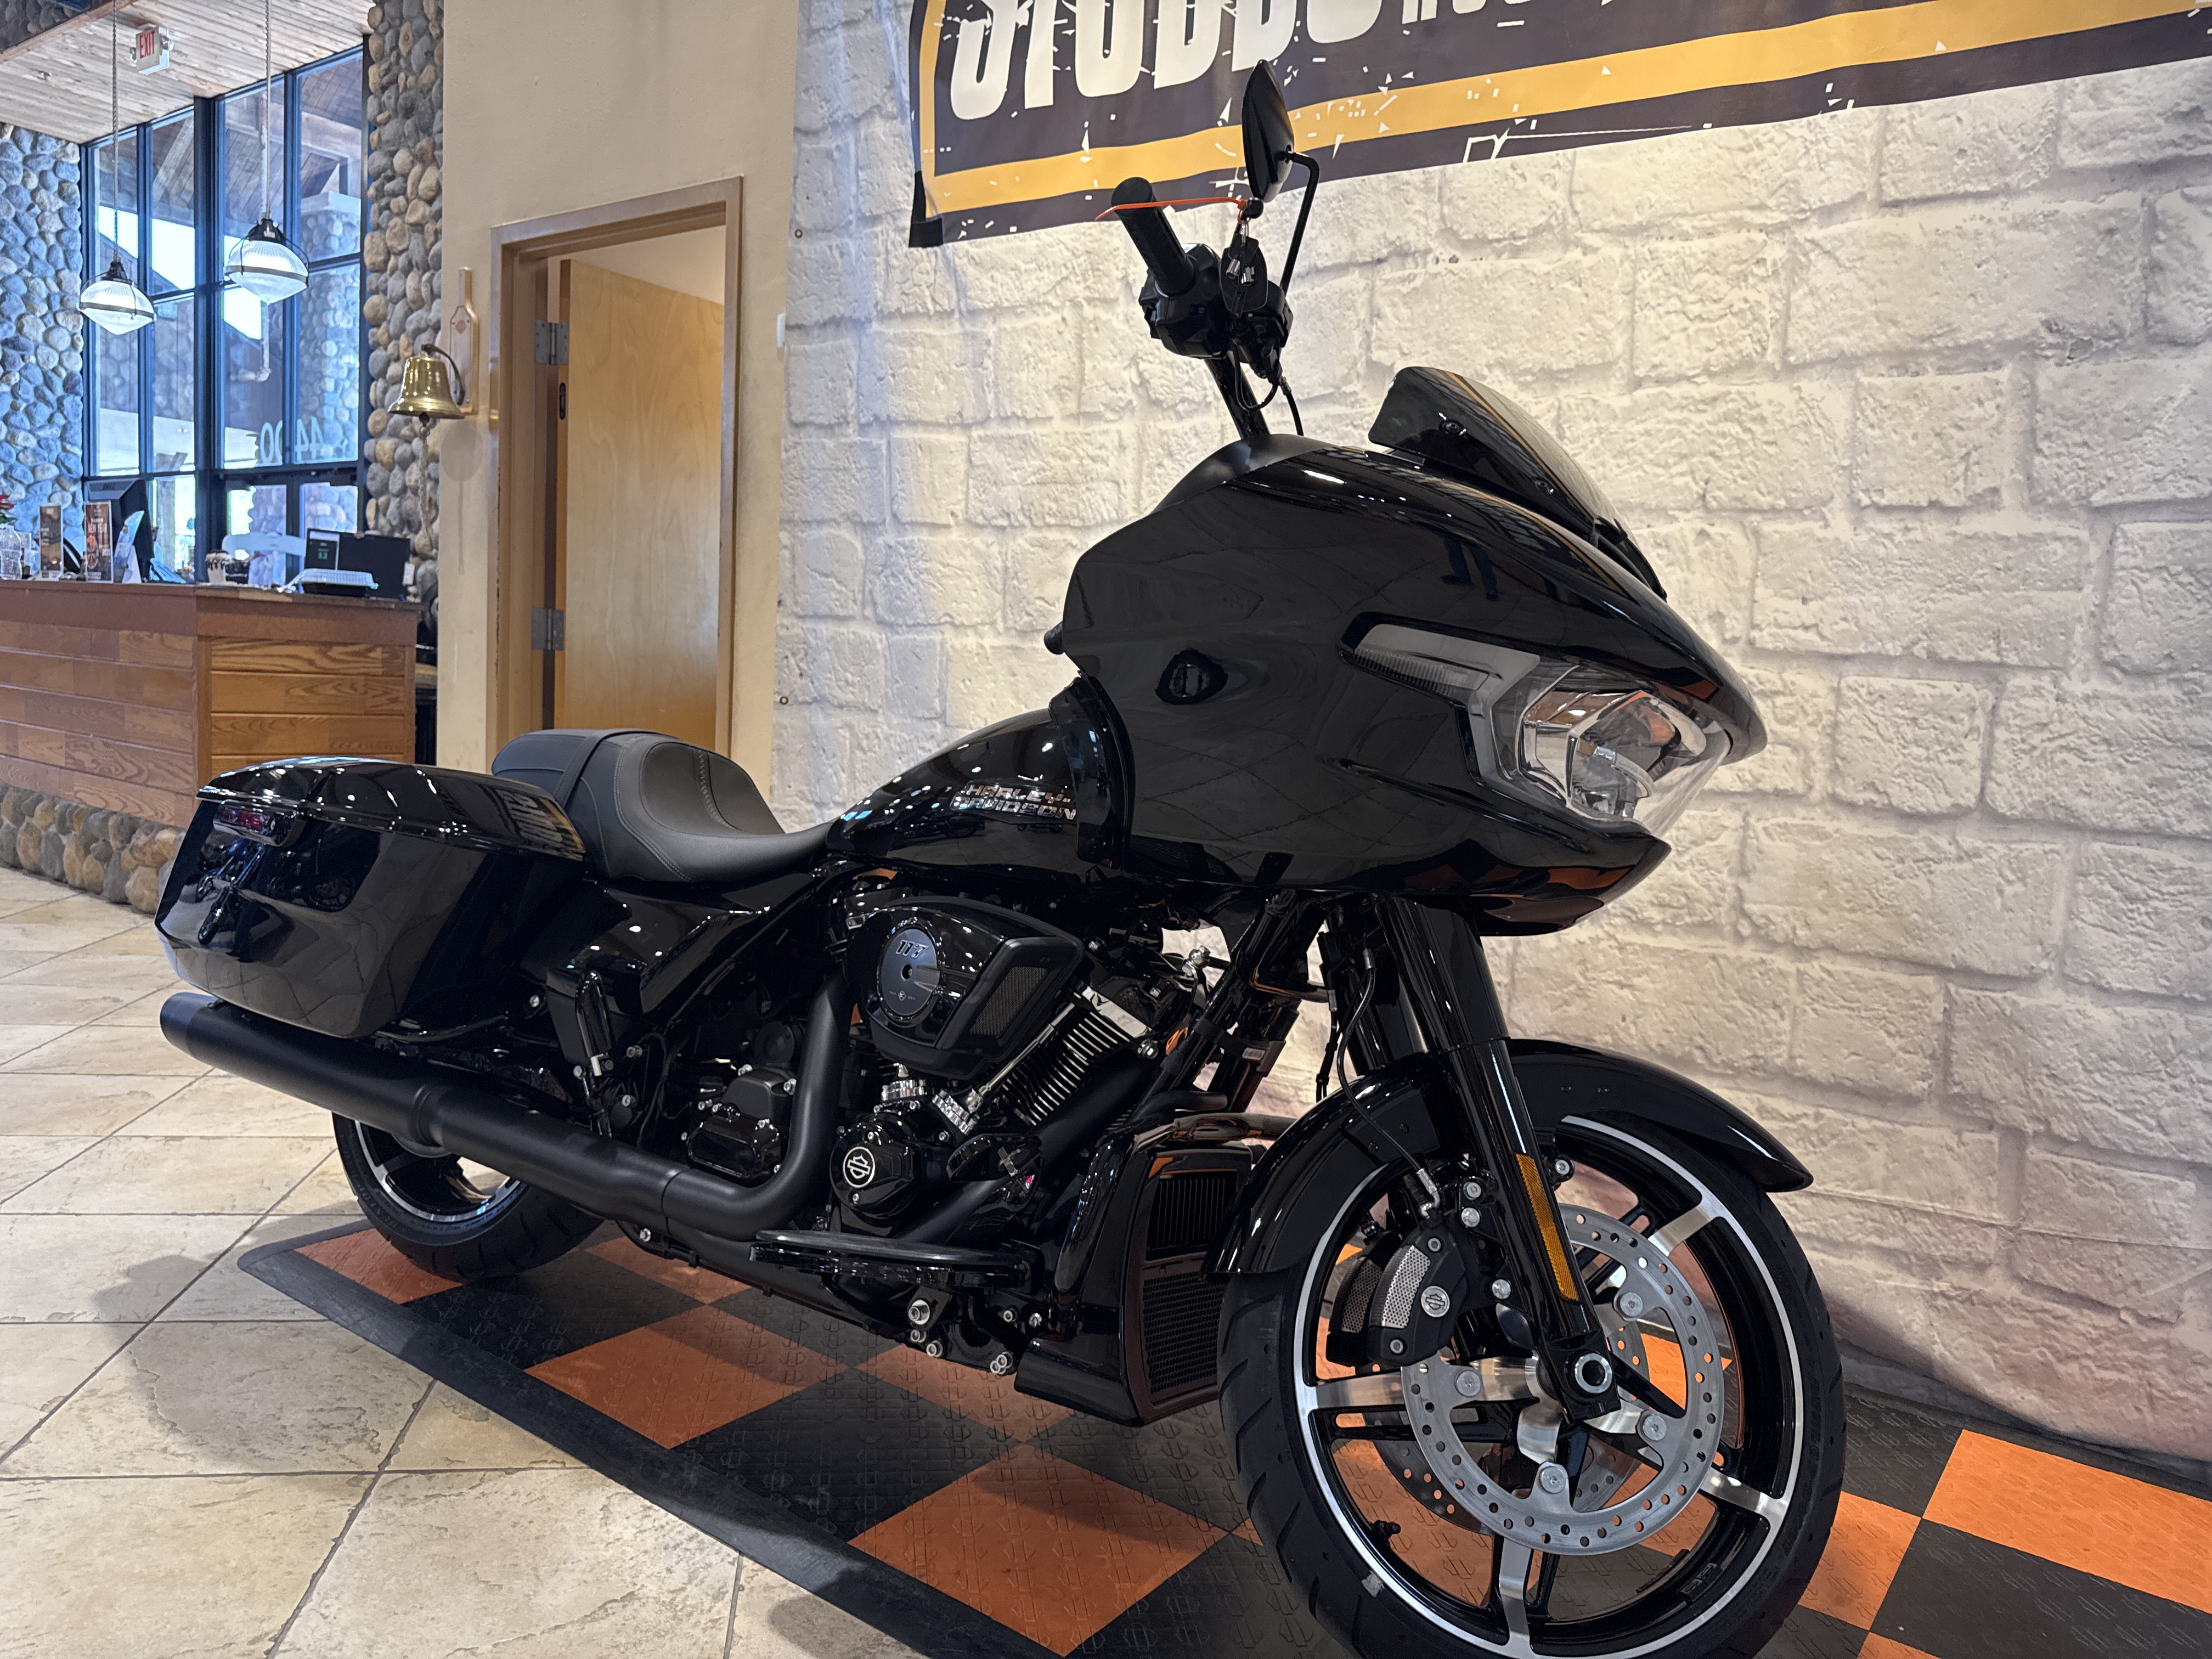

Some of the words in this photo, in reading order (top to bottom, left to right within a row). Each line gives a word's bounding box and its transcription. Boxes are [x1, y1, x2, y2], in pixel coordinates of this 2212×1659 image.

[139, 30, 155, 59] EXIT
[950, 797, 1077, 820] DAVIDSON
[895, 939, 929, 958] 117
